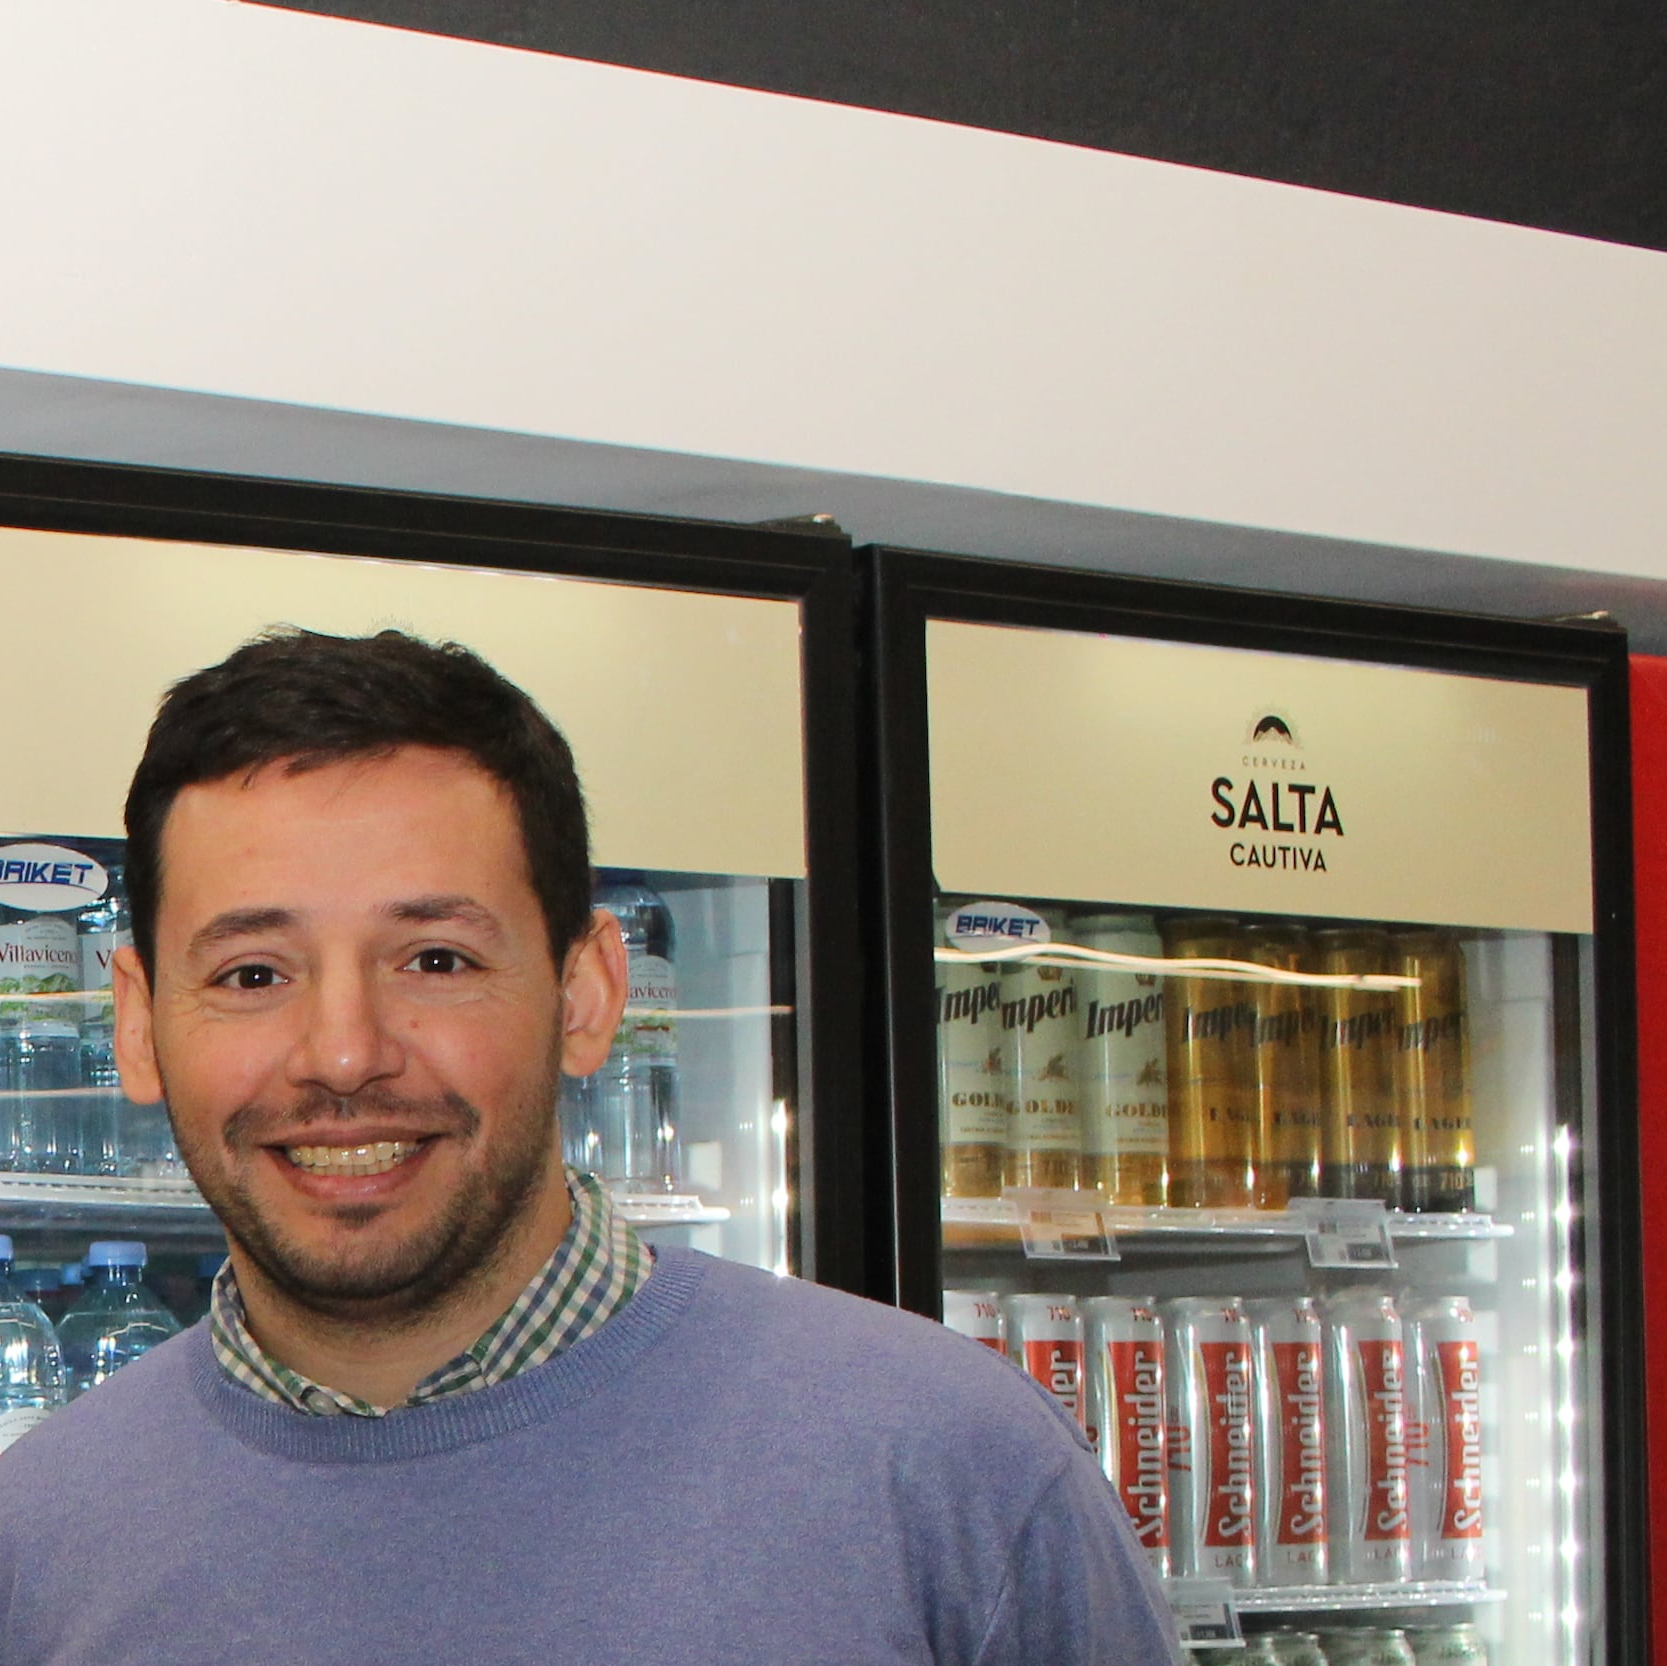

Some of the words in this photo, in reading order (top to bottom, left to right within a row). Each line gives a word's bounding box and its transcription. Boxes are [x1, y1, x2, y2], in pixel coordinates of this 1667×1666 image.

[1211, 776, 1344, 836] SALTA
[1242, 756, 1306, 770] CERVEZA
[955, 914, 1041, 938] BRIKET
[1230, 843, 1327, 872] CAUTIVA
[1124, 1350, 1164, 1540] Schneider
[1215, 1350, 1252, 1539] Schneider
[1287, 1350, 1324, 1536] Schneider
[1373, 1347, 1408, 1533] Schneider
[1451, 1348, 1483, 1532] Schneider
